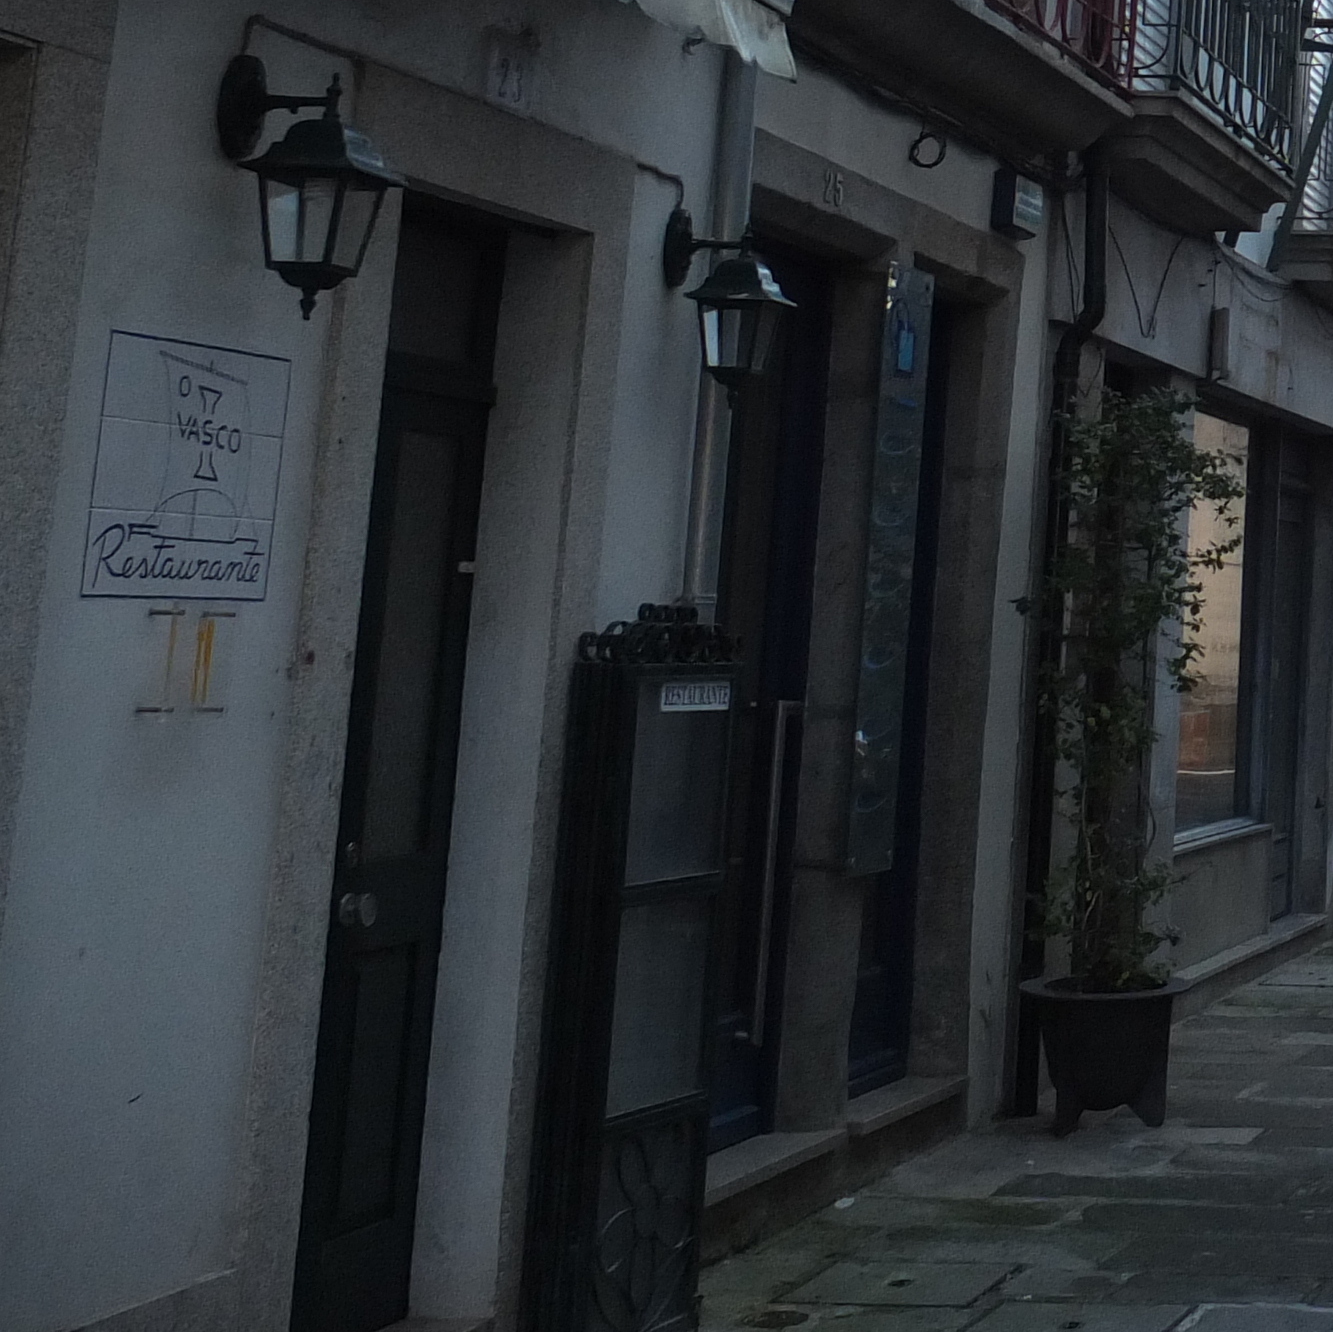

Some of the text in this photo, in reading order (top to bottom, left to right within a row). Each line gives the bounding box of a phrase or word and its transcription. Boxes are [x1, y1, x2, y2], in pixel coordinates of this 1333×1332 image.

[822, 168, 844, 208] 25
[178, 375, 192, 398] O
[177, 411, 242, 454] VASCO
[92, 523, 265, 589] Restaurante
